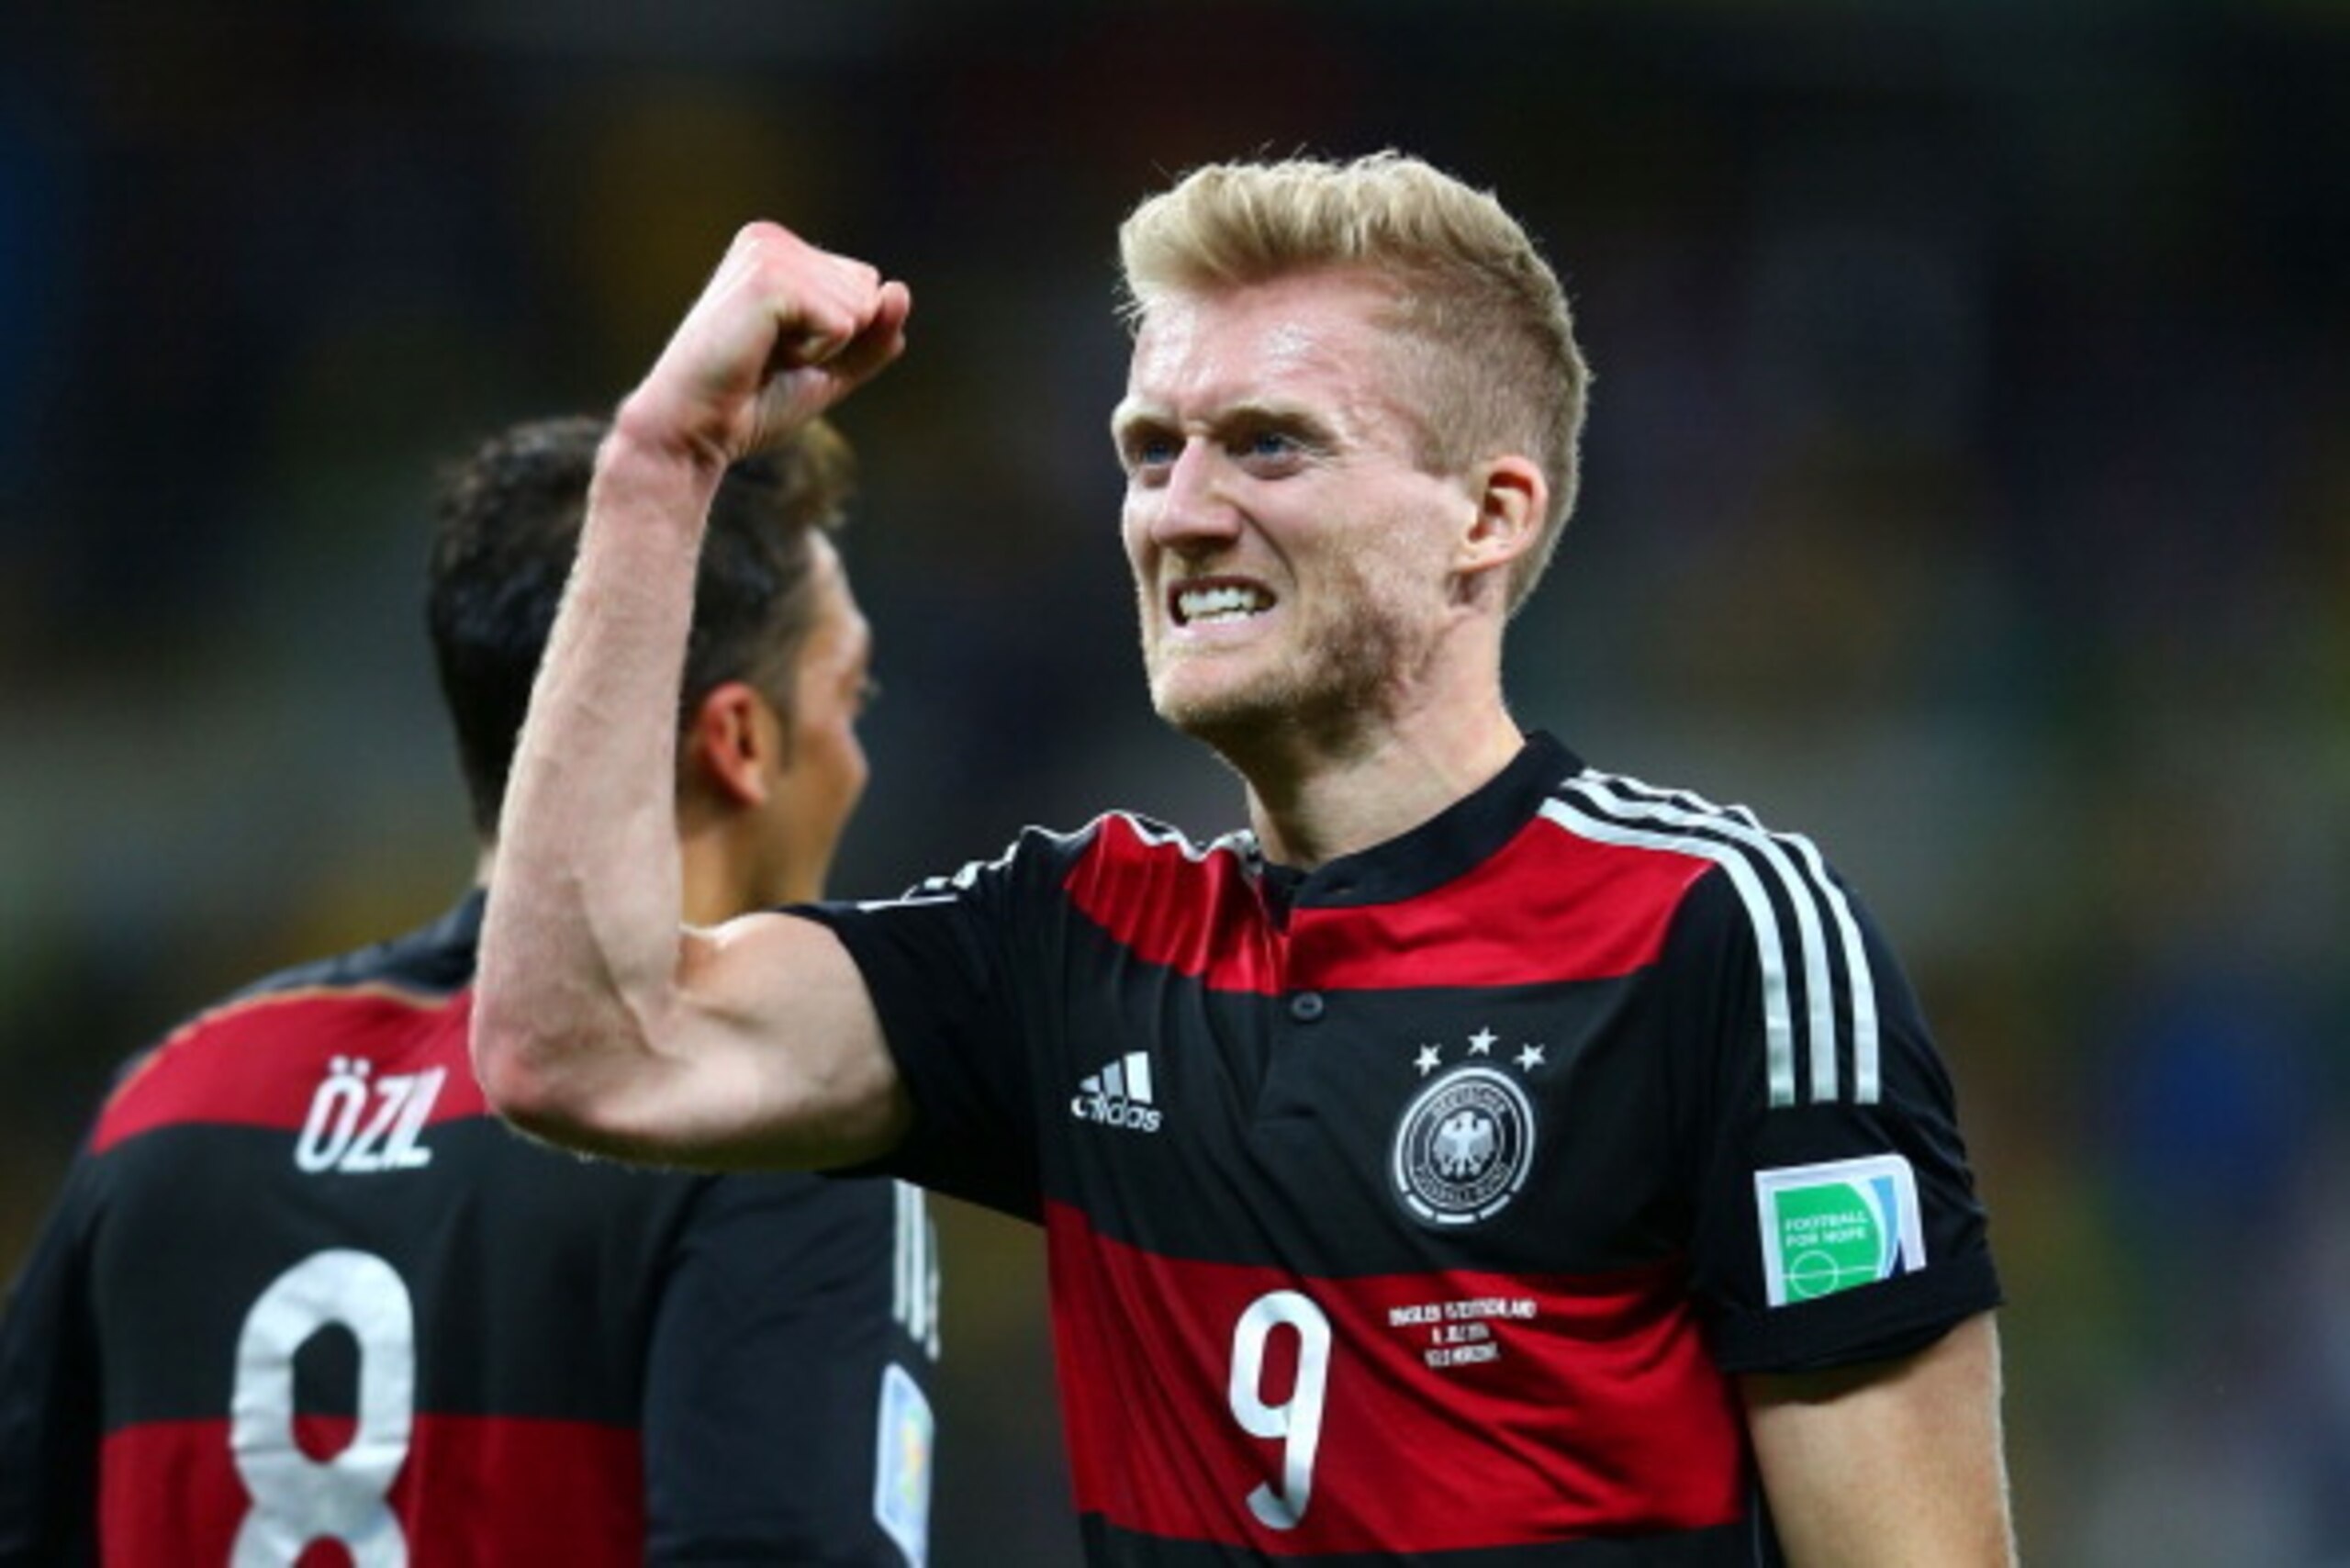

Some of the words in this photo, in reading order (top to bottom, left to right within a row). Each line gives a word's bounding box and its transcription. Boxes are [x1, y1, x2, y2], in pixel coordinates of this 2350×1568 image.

[1785, 1210, 1867, 1232] FOOTBALL
[1785, 1234, 1818, 1248] FOR
[229, 1249, 415, 1568] 8
[1230, 1290, 1331, 1529] 9
